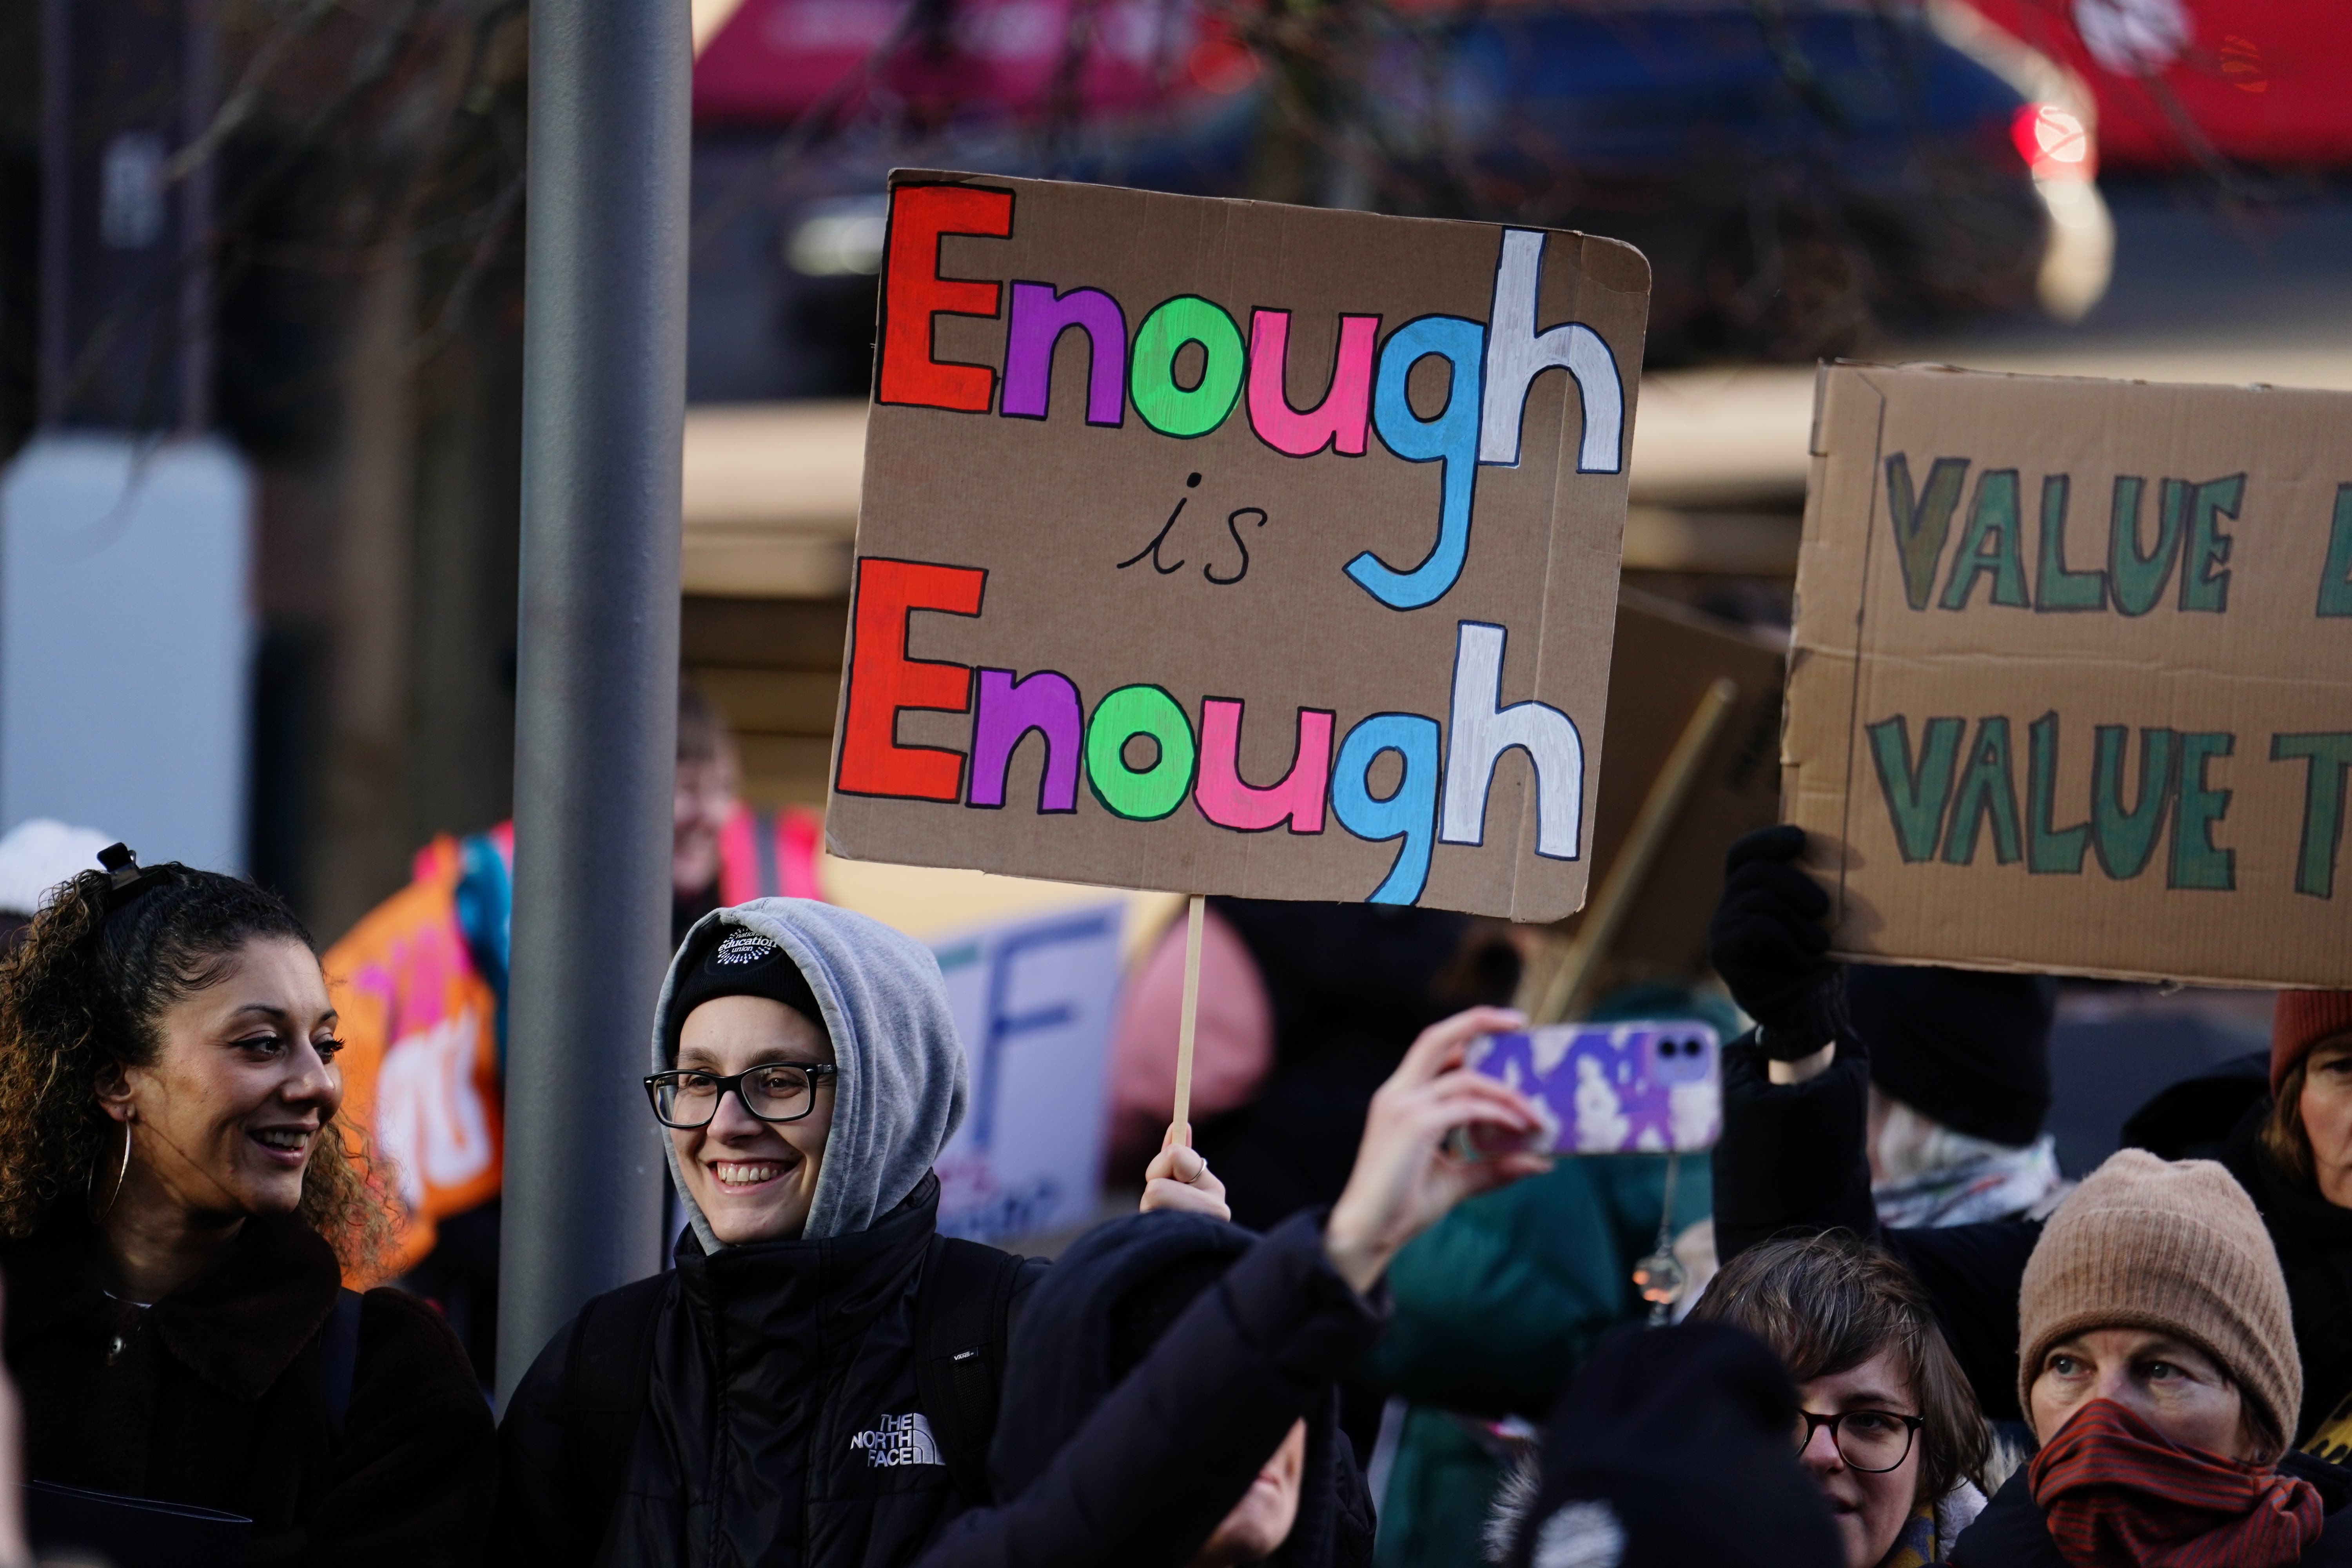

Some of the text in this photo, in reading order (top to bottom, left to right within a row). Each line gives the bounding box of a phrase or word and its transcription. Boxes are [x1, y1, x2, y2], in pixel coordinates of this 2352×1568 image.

[875, 181, 1625, 611] Enough
[1117, 471, 1268, 585] is
[1884, 451, 2248, 618] VALUE
[834, 556, 1585, 906] Enough
[1865, 710, 2236, 891] VALUE
[718, 936, 777, 951] education
[954, 1351, 970, 1360] VANS
[850, 1430, 912, 1450] NORTH
[880, 1413, 913, 1432] THE
[867, 1447, 912, 1468] FACE
